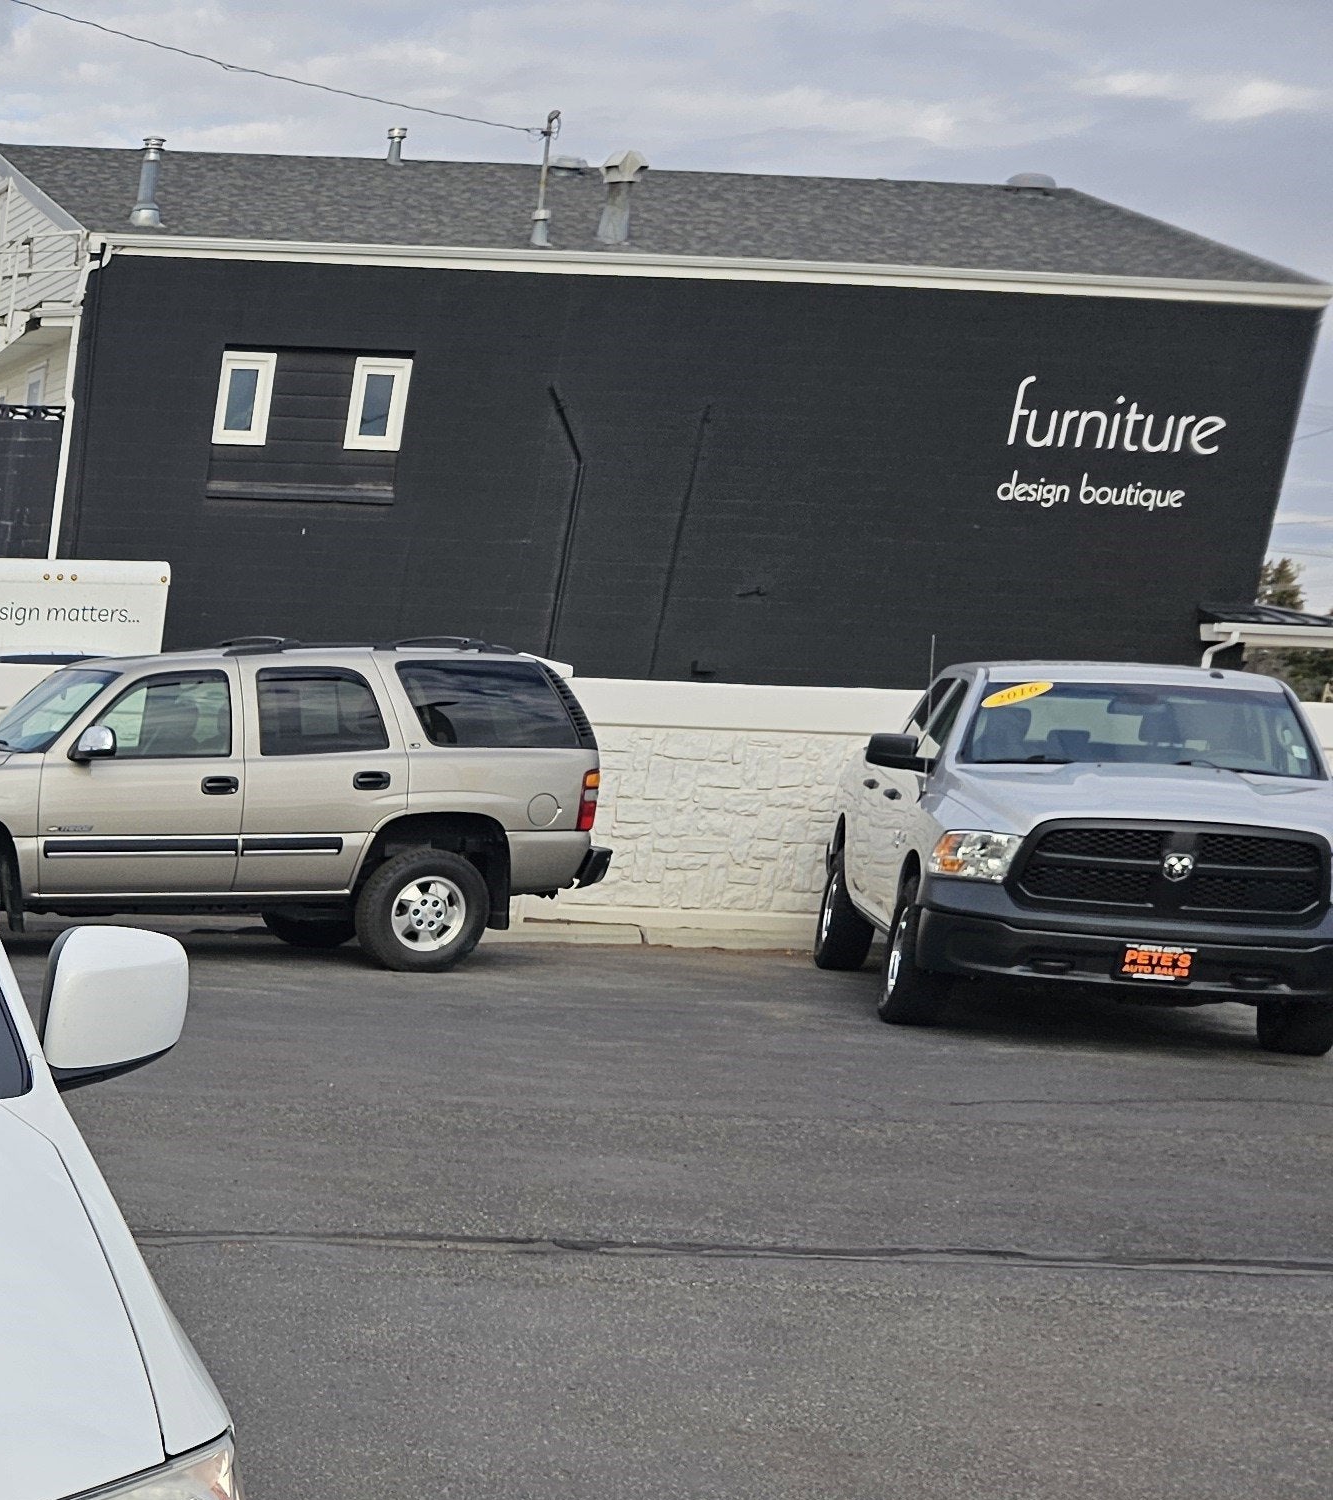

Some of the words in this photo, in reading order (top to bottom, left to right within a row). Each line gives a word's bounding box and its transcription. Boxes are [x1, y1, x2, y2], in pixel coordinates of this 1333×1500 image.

[1006, 375, 1227, 455] furniture
[996, 469, 1070, 508] design
[1079, 472, 1186, 512] boutique
[46, 604, 141, 624] matters...
[1124, 949, 1191, 967] PETE'S
[1121, 964, 1151, 973] AUTO
